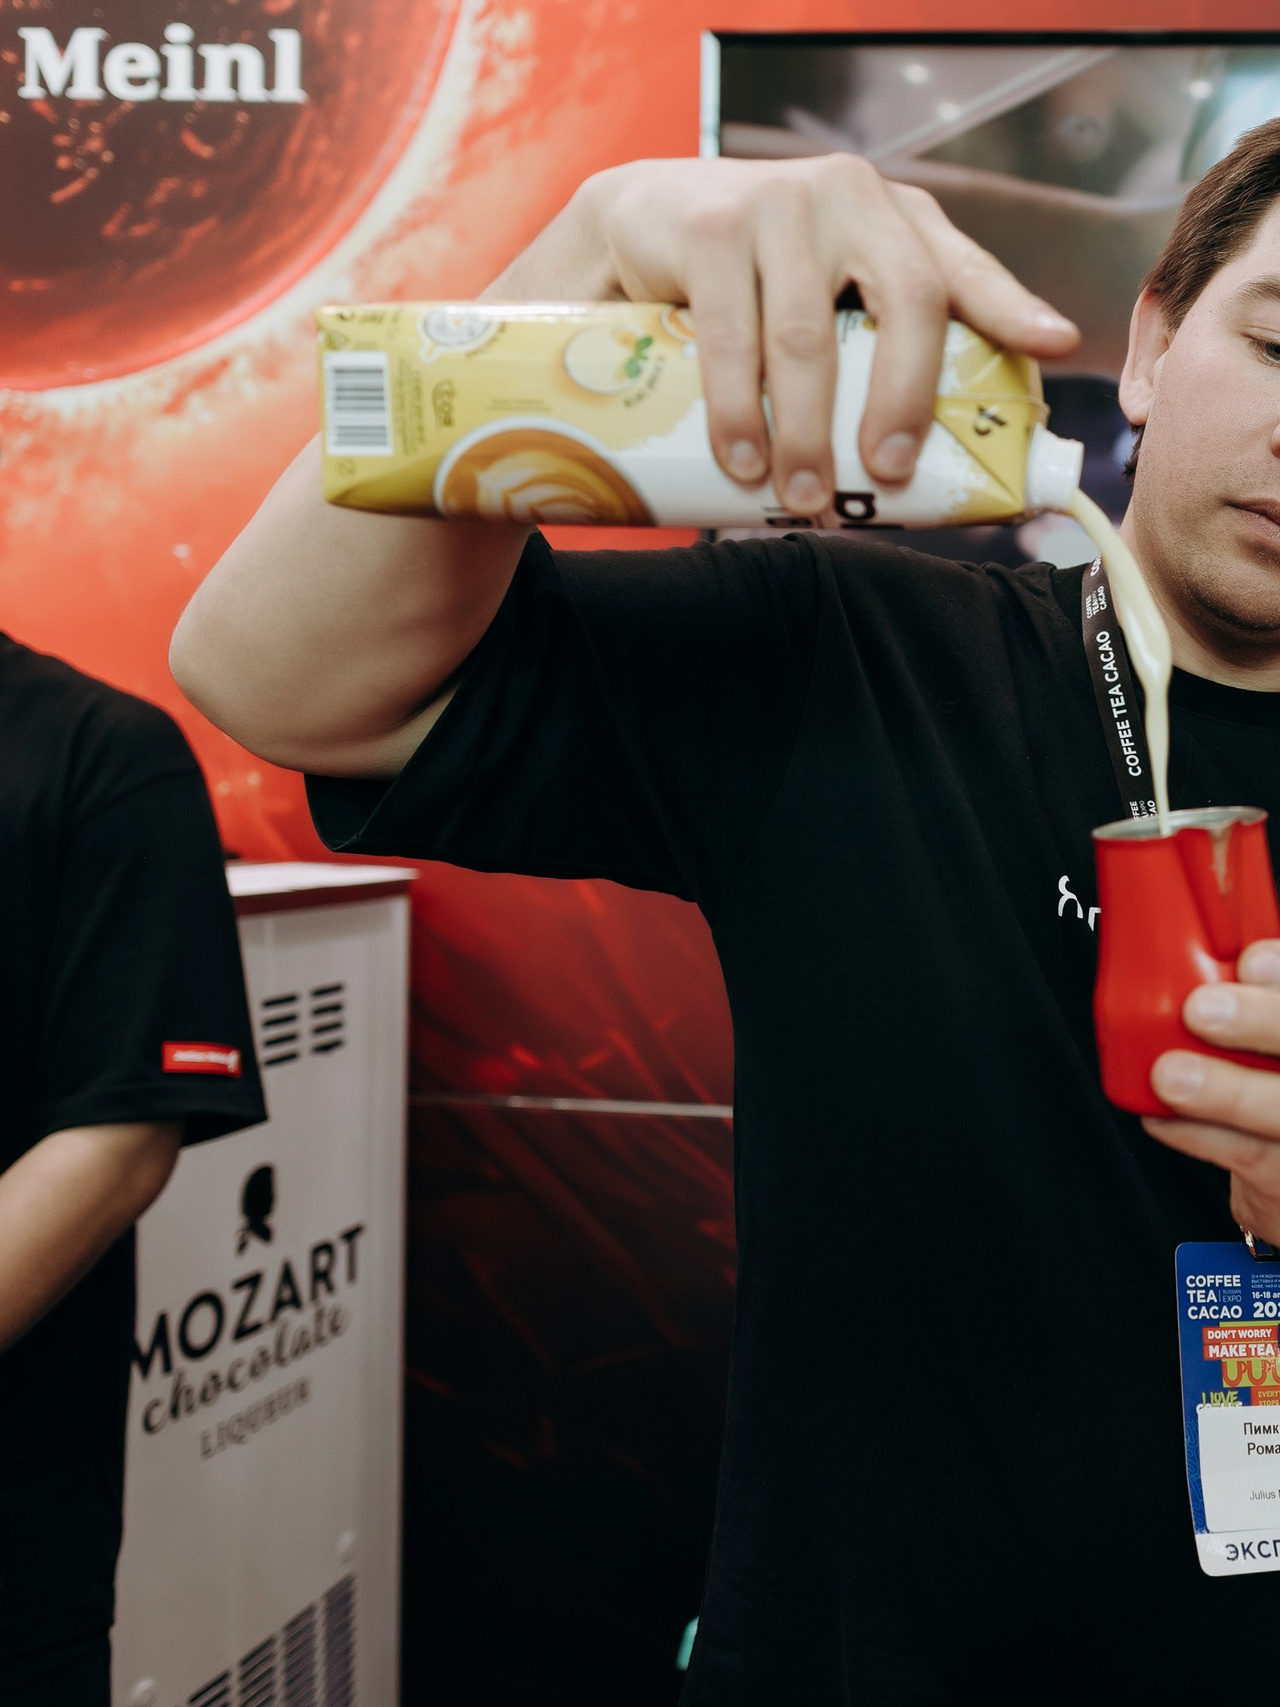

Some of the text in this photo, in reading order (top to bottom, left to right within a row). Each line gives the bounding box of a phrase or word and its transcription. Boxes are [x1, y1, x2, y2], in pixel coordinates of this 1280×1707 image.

[17, 22, 308, 103] Meinl
[1096, 630, 1142, 777] COFFEE TEA CACAO
[1186, 1275, 1241, 1287] COFFEE
[131, 1223, 365, 1380] MOZART
[1187, 1290, 1217, 1303] TEA
[1252, 1291, 1271, 1299] 16-18
[1188, 1306, 1242, 1319] CACAO
[1237, 1329, 1272, 1339] WORRY
[1209, 1343, 1276, 1358] MAKE TEA
[142, 1303, 348, 1435] chocolate
[1249, 1490, 1276, 1501] Julius
